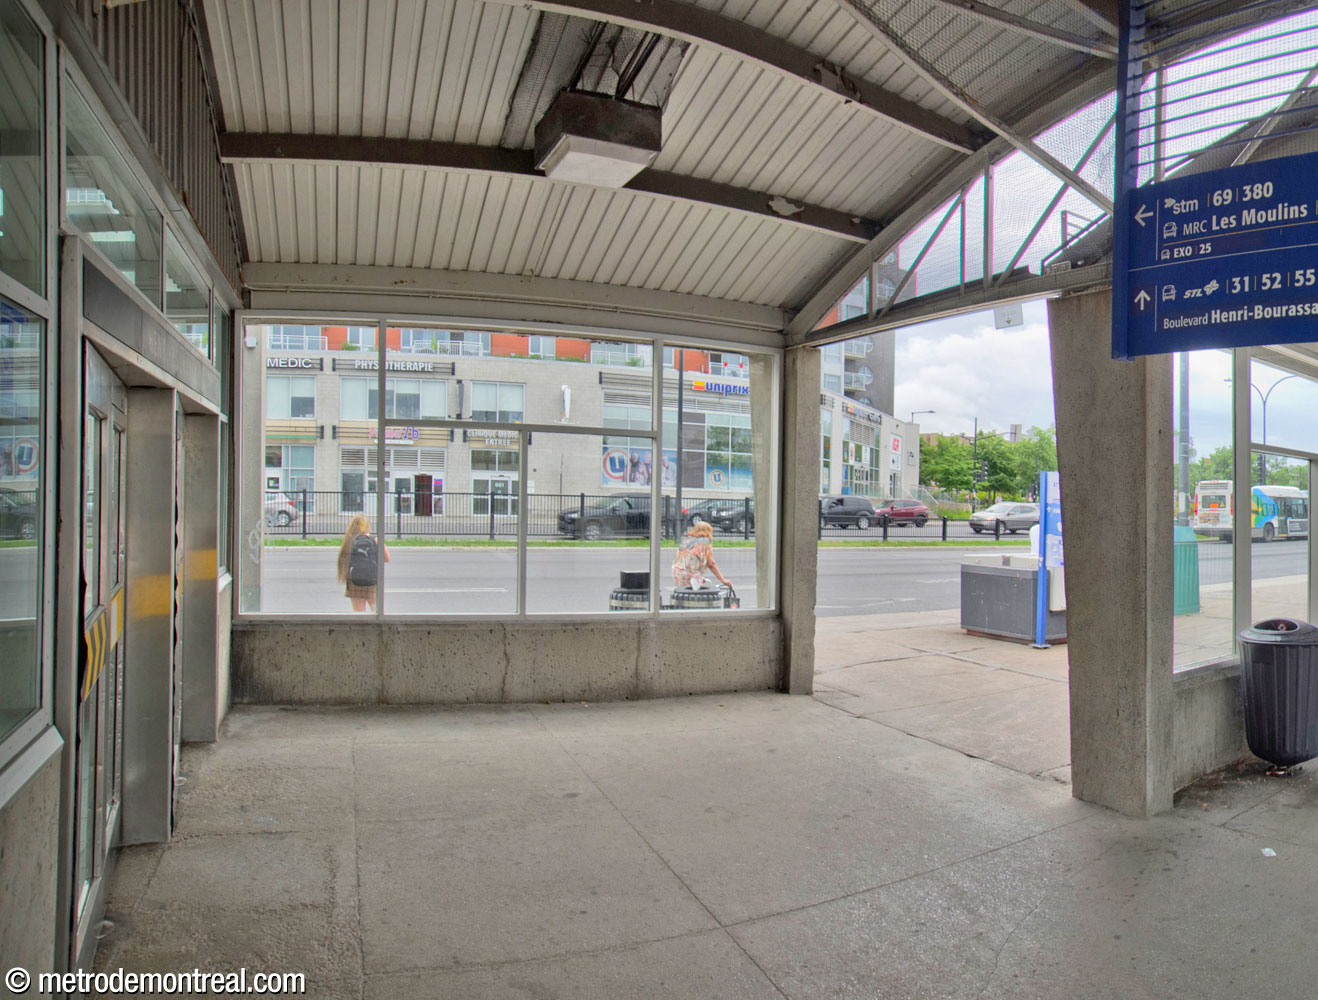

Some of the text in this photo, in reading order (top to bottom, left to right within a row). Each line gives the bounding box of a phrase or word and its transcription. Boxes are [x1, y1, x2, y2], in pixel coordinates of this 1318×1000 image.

[1172, 181, 1273, 215] stm 69 380
[1183, 220, 1207, 236] MRC
[1212, 214, 1236, 231] Les
[1241, 202, 1308, 226] Moulins
[1174, 243, 1212, 259] EXO 25
[1183, 288, 1203, 299] STL
[1231, 276, 1250, 294] 31
[1261, 273, 1282, 290] 52
[1294, 269, 1315, 287] 55
[1163, 313, 1208, 330] Boulevard
[266, 357, 313, 368] MEDIC
[706, 382, 749, 397] uniprix
